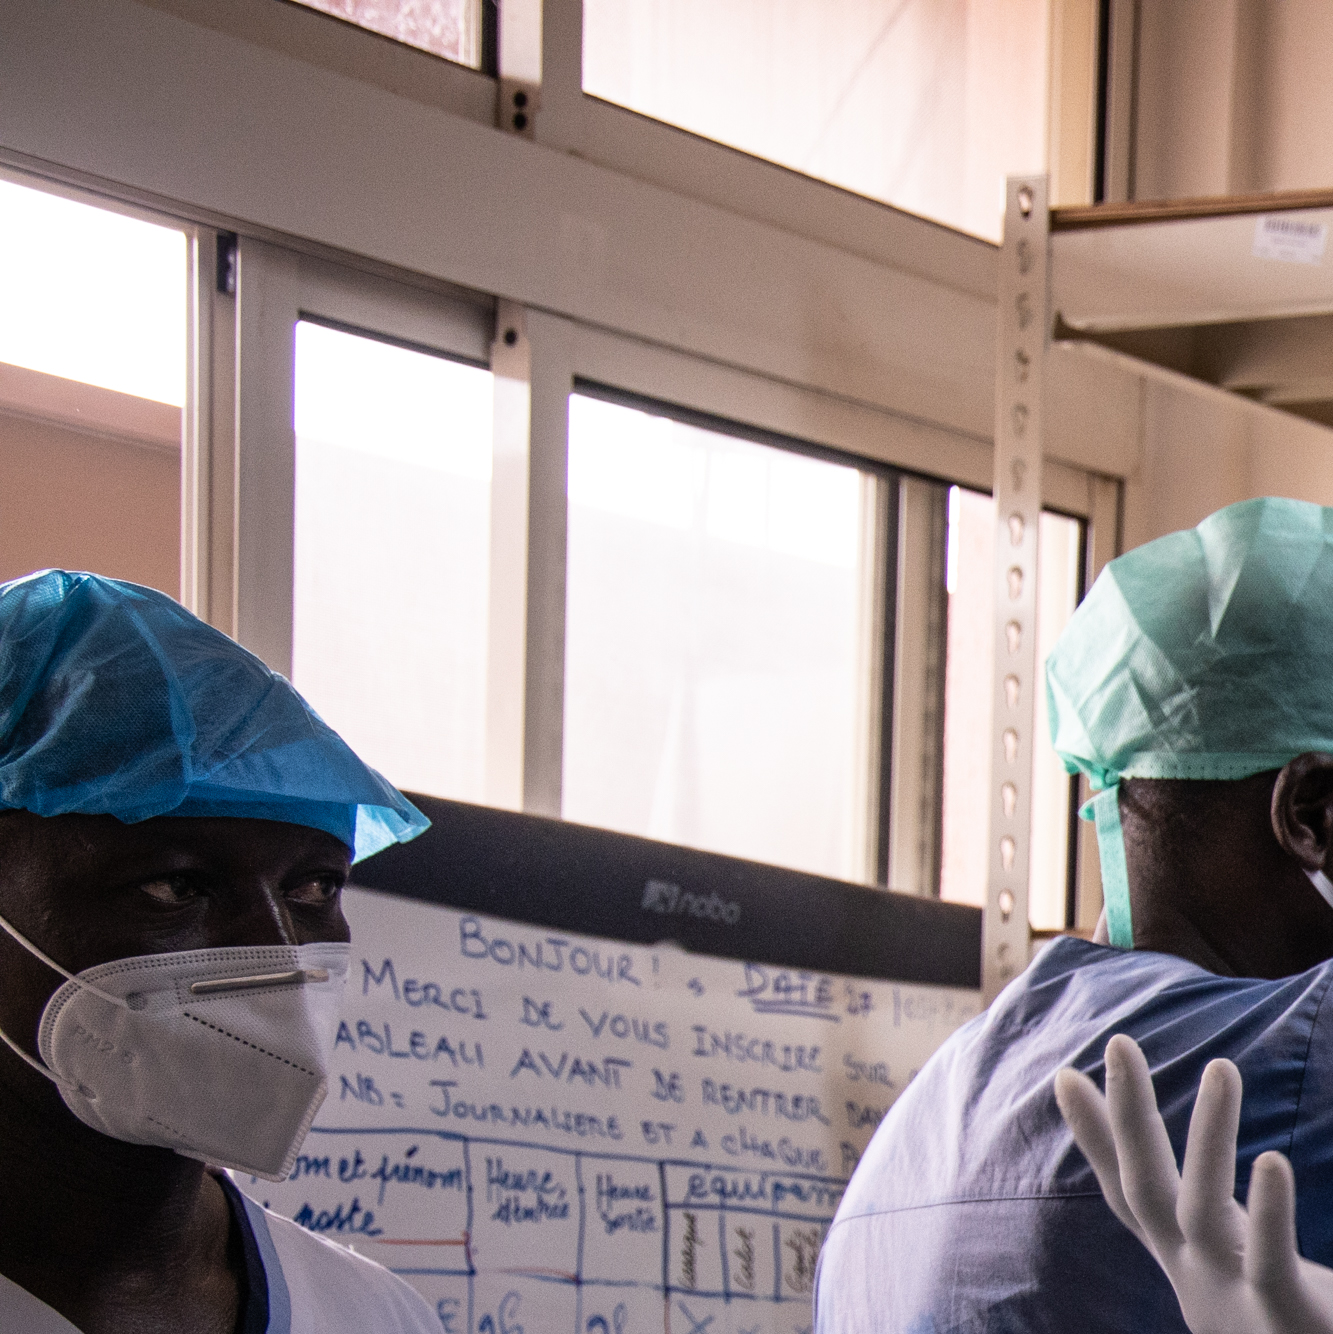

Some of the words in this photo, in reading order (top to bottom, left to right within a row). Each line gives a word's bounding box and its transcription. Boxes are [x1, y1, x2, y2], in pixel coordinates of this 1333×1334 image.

[681, 892, 741, 924] nobo
[458, 914, 642, 986] BONJOUR
[360, 958, 488, 1019] MERCI
[519, 994, 564, 1030] DE
[577, 1007, 670, 1051] VOUS
[691, 1025, 823, 1074] INSCRIRE
[334, 1020, 485, 1069] ABLEAU
[511, 1047, 631, 1089] AVANT
[651, 1068, 685, 1104] DE
[701, 1076, 831, 1127] RENTRER
[640, 1119, 677, 1146] ET
[337, 1148, 368, 1183] et
[371, 1145, 464, 1206] prénom
